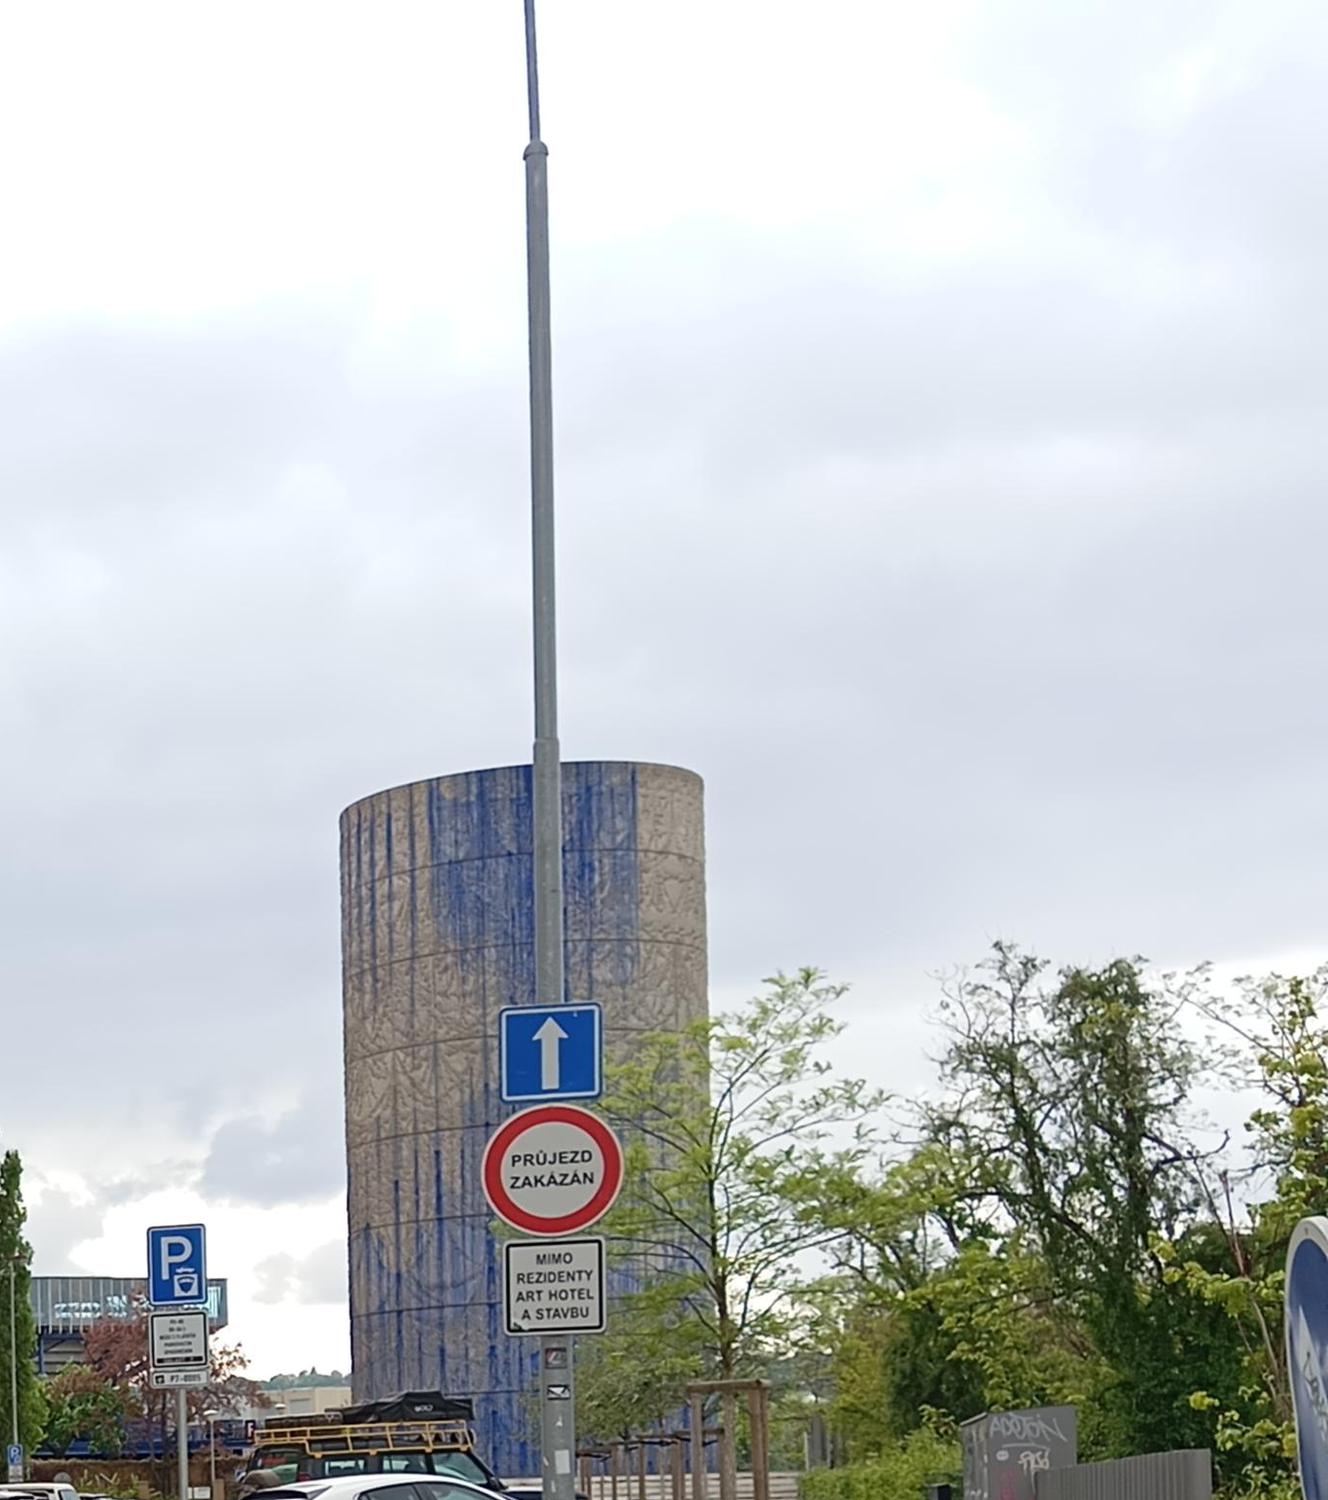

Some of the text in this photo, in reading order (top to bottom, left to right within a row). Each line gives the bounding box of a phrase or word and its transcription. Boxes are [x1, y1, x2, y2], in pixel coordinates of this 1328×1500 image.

[511, 1149, 593, 1168] PRŮJEZD
[510, 1169, 594, 1189] ZAKÁZÁN
[160, 1235, 193, 1281] P
[535, 1252, 573, 1265] MIMO
[516, 1269, 594, 1285] REZIDENTY
[515, 1288, 594, 1303] ART HOTEL
[521, 1306, 589, 1321] A STAVBU
